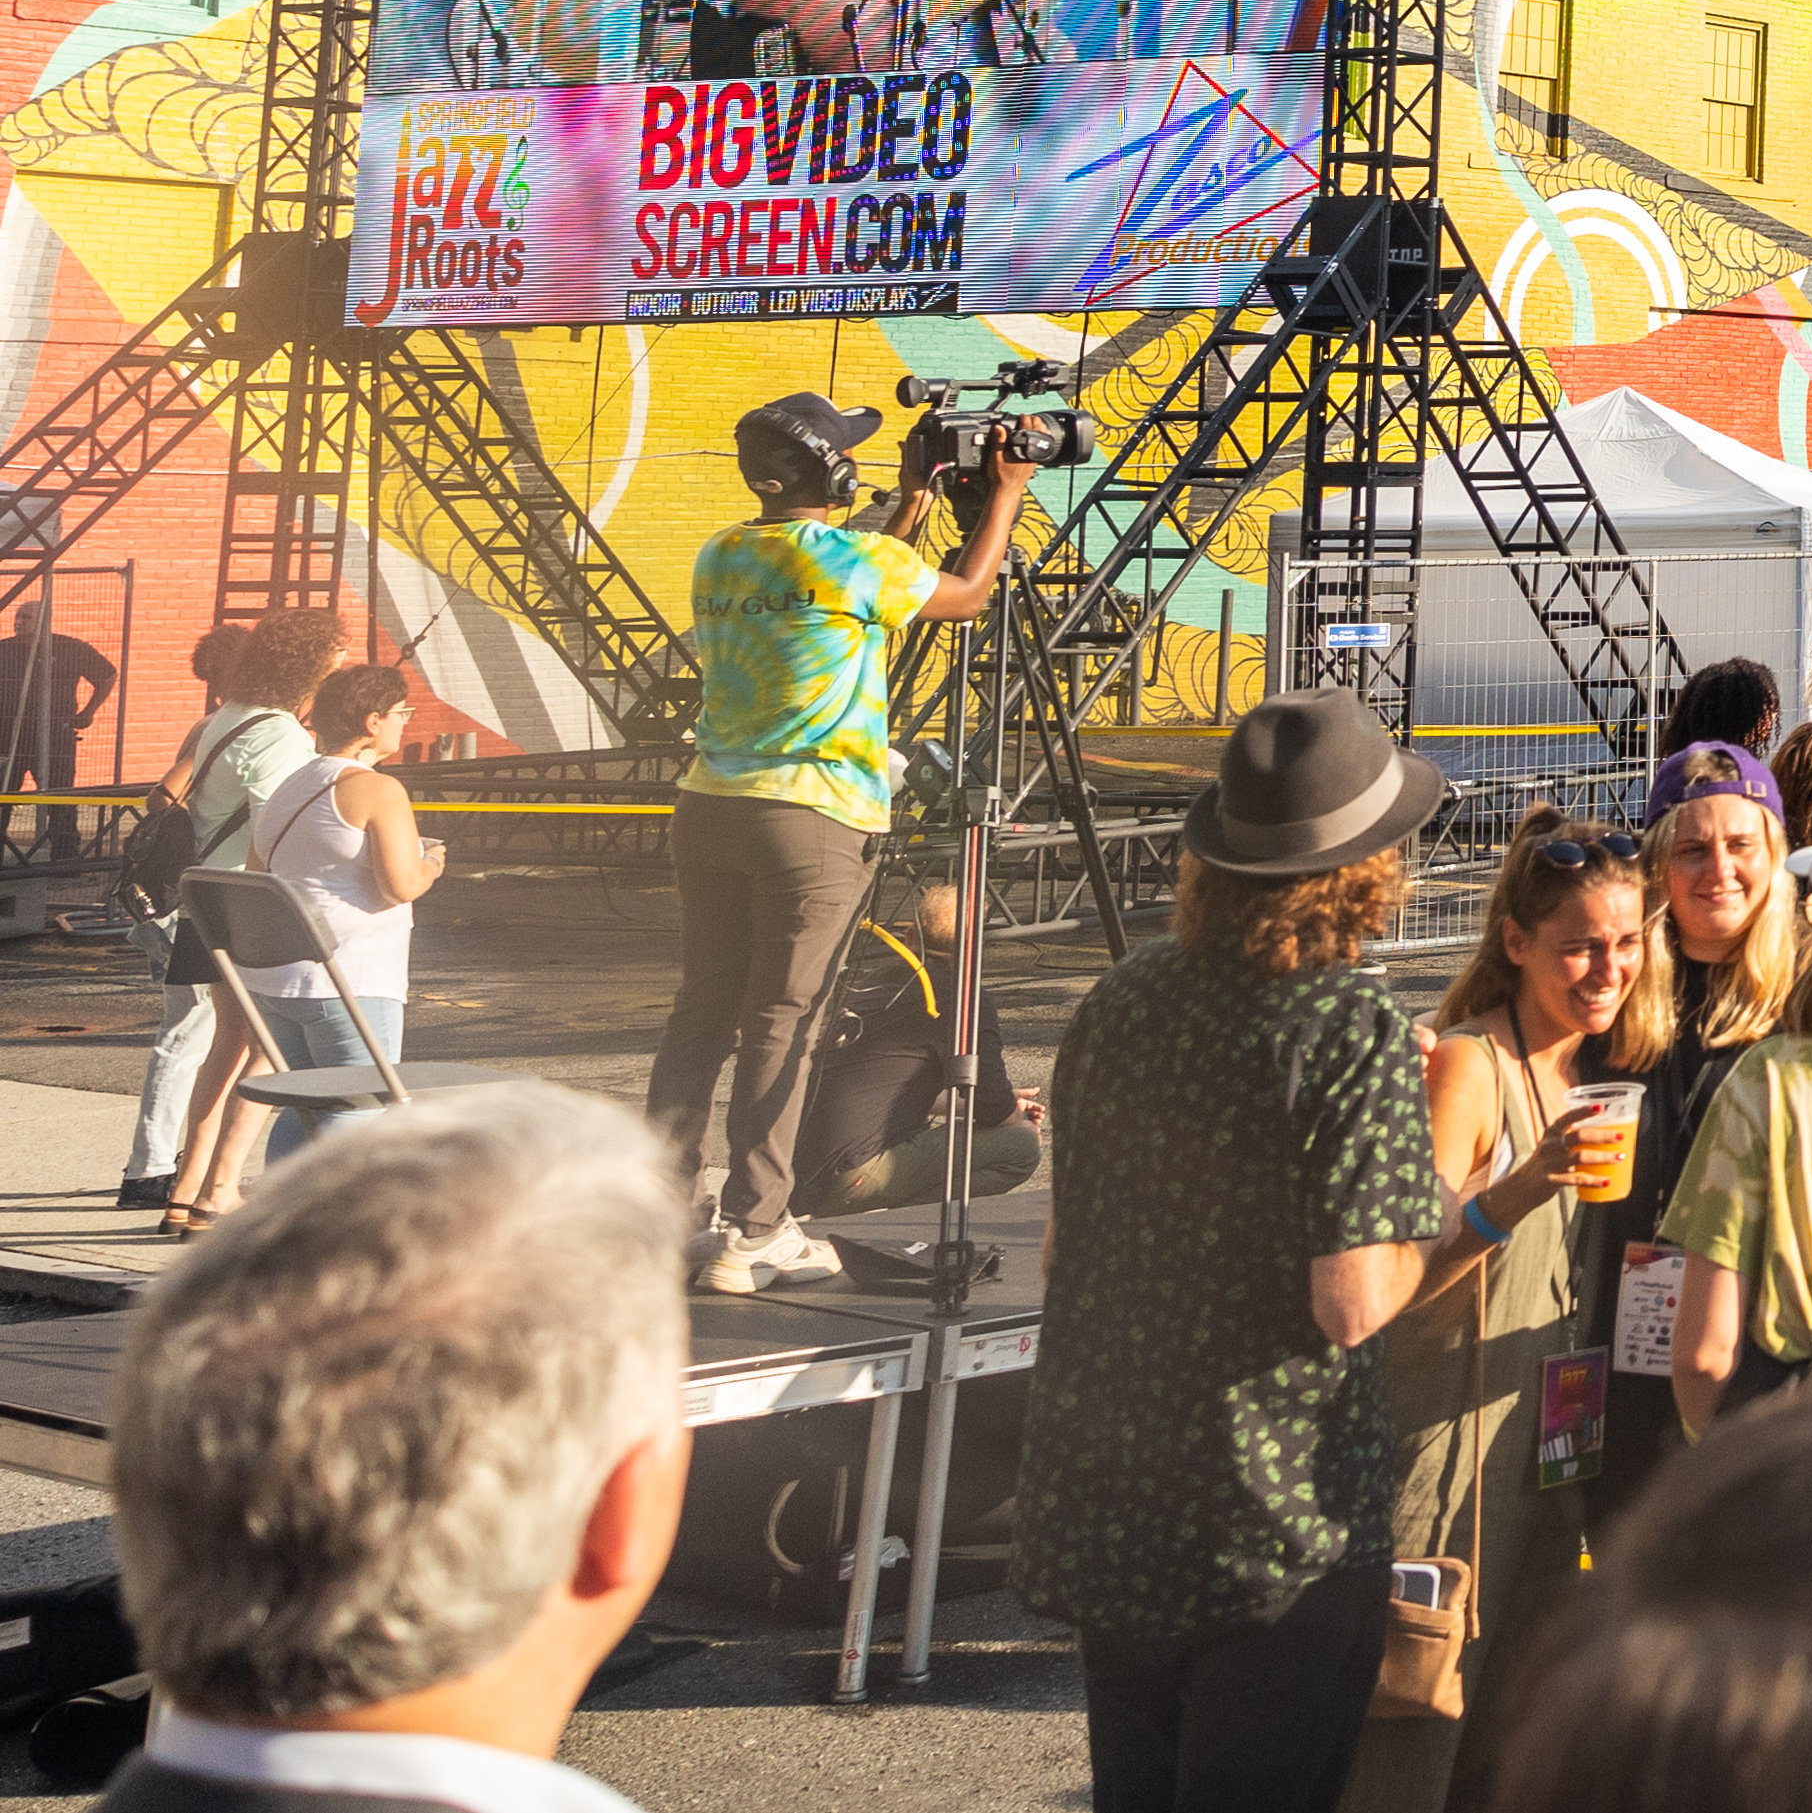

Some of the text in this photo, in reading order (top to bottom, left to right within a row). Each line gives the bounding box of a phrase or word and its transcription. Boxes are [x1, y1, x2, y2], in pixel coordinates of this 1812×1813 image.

[416, 96, 536, 132] SPRINGFIELD
[637, 70, 974, 191] BIGVIDEO
[404, 213, 527, 293] Roots
[630, 191, 968, 281] SCREEN.COM
[627, 285, 919, 317] INDOOR OUTDOOR LED VIDEO DISPLAYS
[740, 588, 816, 616] GUY
